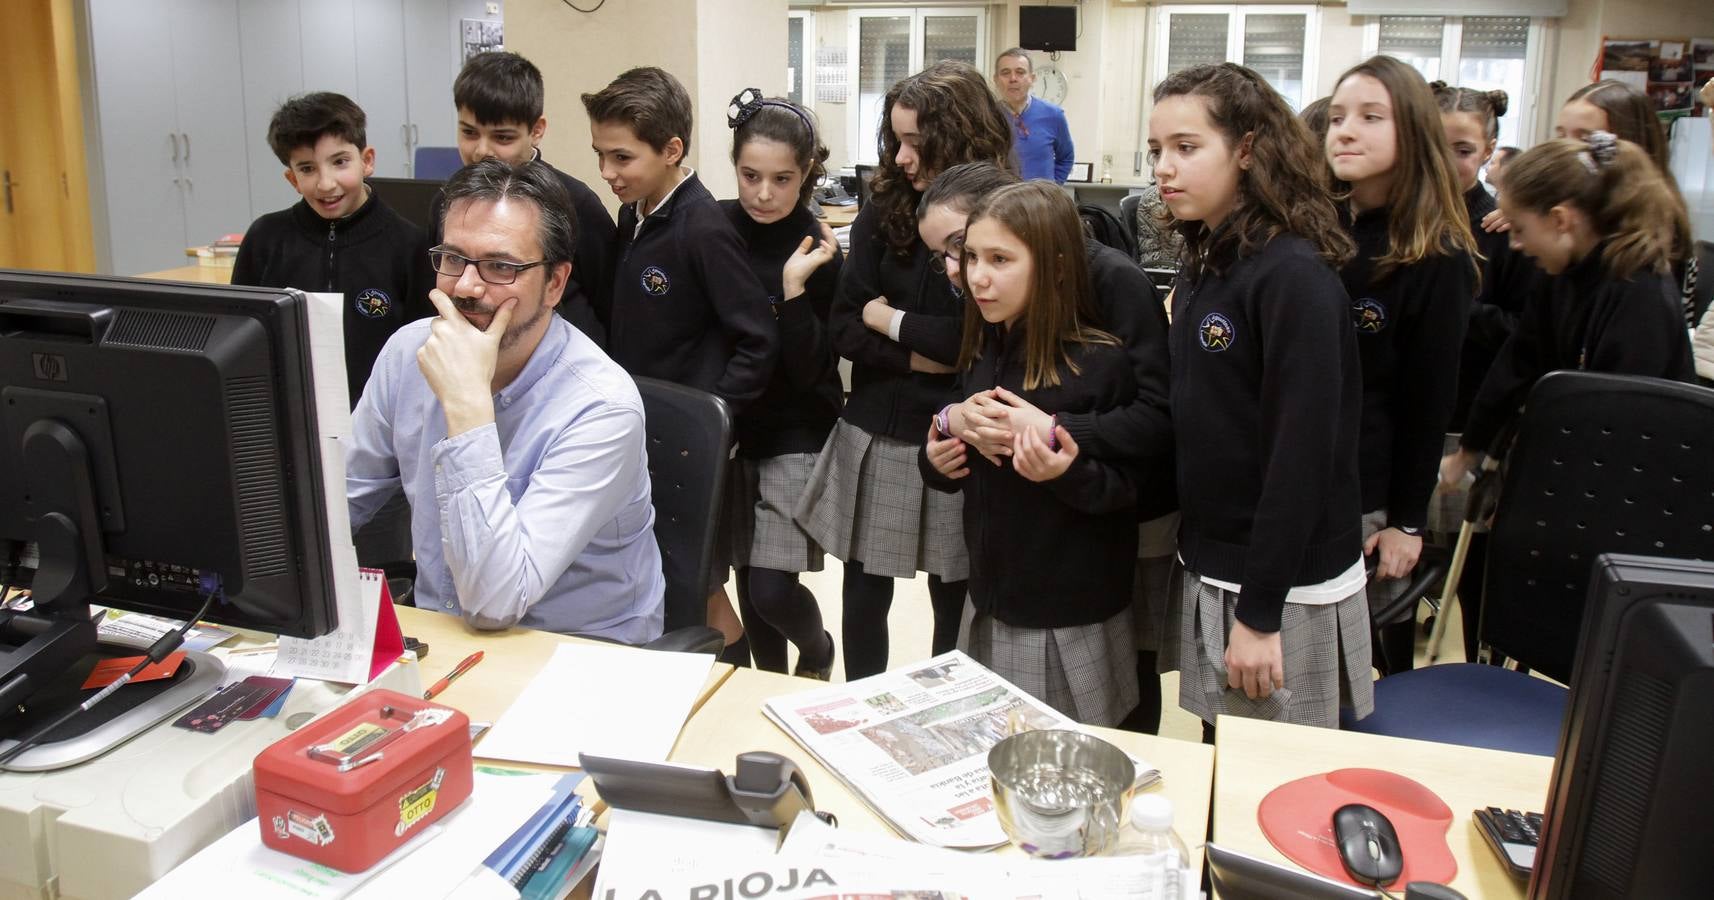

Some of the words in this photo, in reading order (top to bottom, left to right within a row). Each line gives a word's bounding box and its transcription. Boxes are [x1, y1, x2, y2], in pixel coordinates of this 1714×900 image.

[930, 775, 963, 788] Bankia
[407, 798, 431, 819] OTTO
[689, 867, 839, 900] RIOJA
